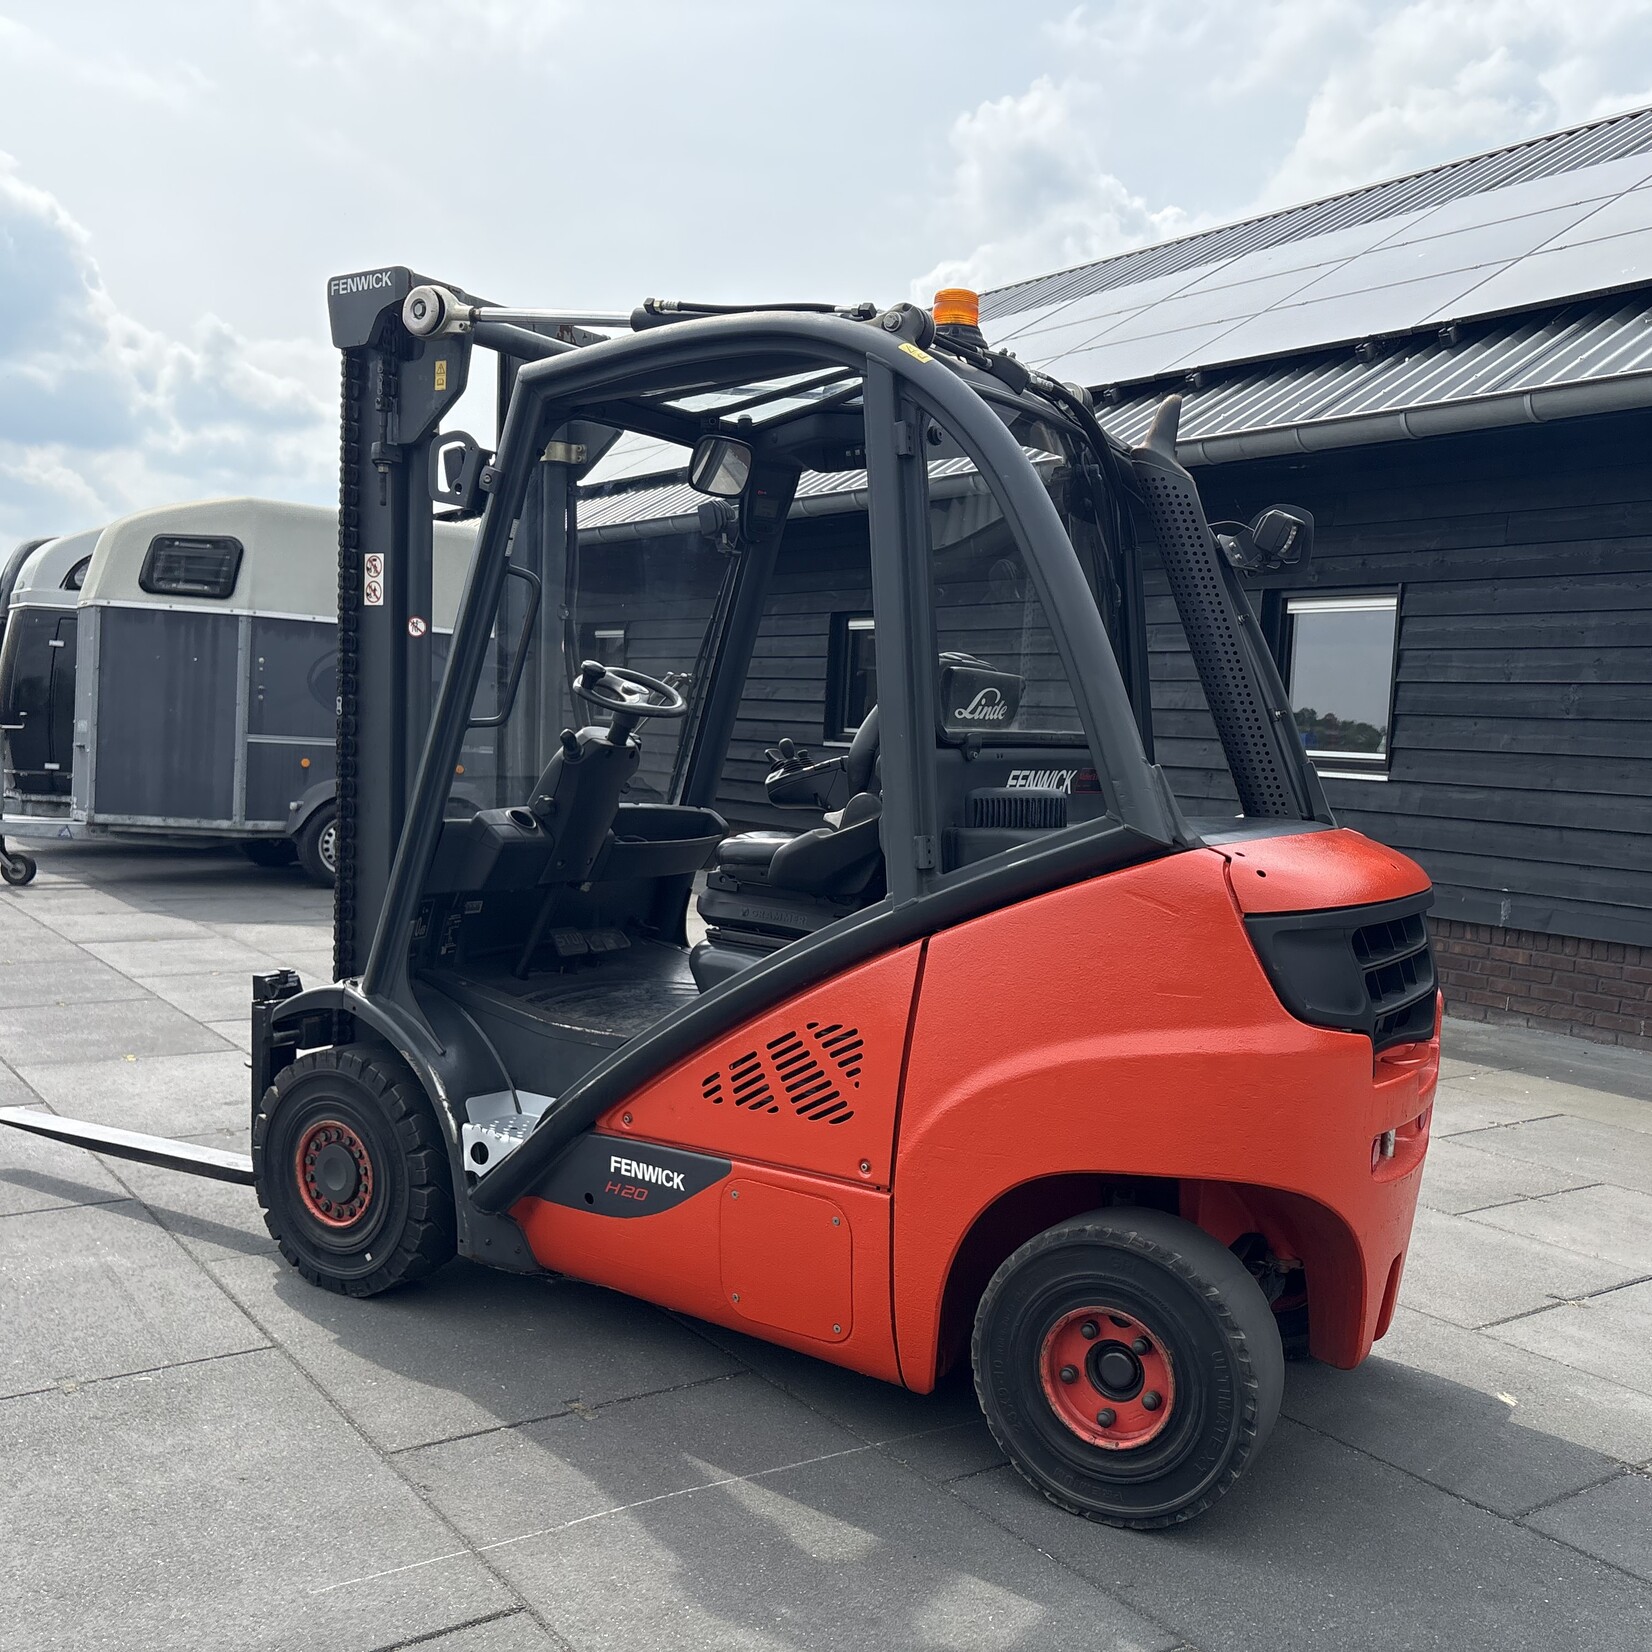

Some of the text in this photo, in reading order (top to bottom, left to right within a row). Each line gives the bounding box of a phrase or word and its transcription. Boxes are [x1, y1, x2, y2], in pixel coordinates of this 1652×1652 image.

[331, 271, 392, 296] FENWICK
[954, 687, 1008, 720] Linde
[1005, 769, 1078, 794] FENWICK
[751, 910, 808, 926] GRAMMER
[610, 1155, 686, 1192] FENWICK
[604, 1180, 649, 1202] H20
